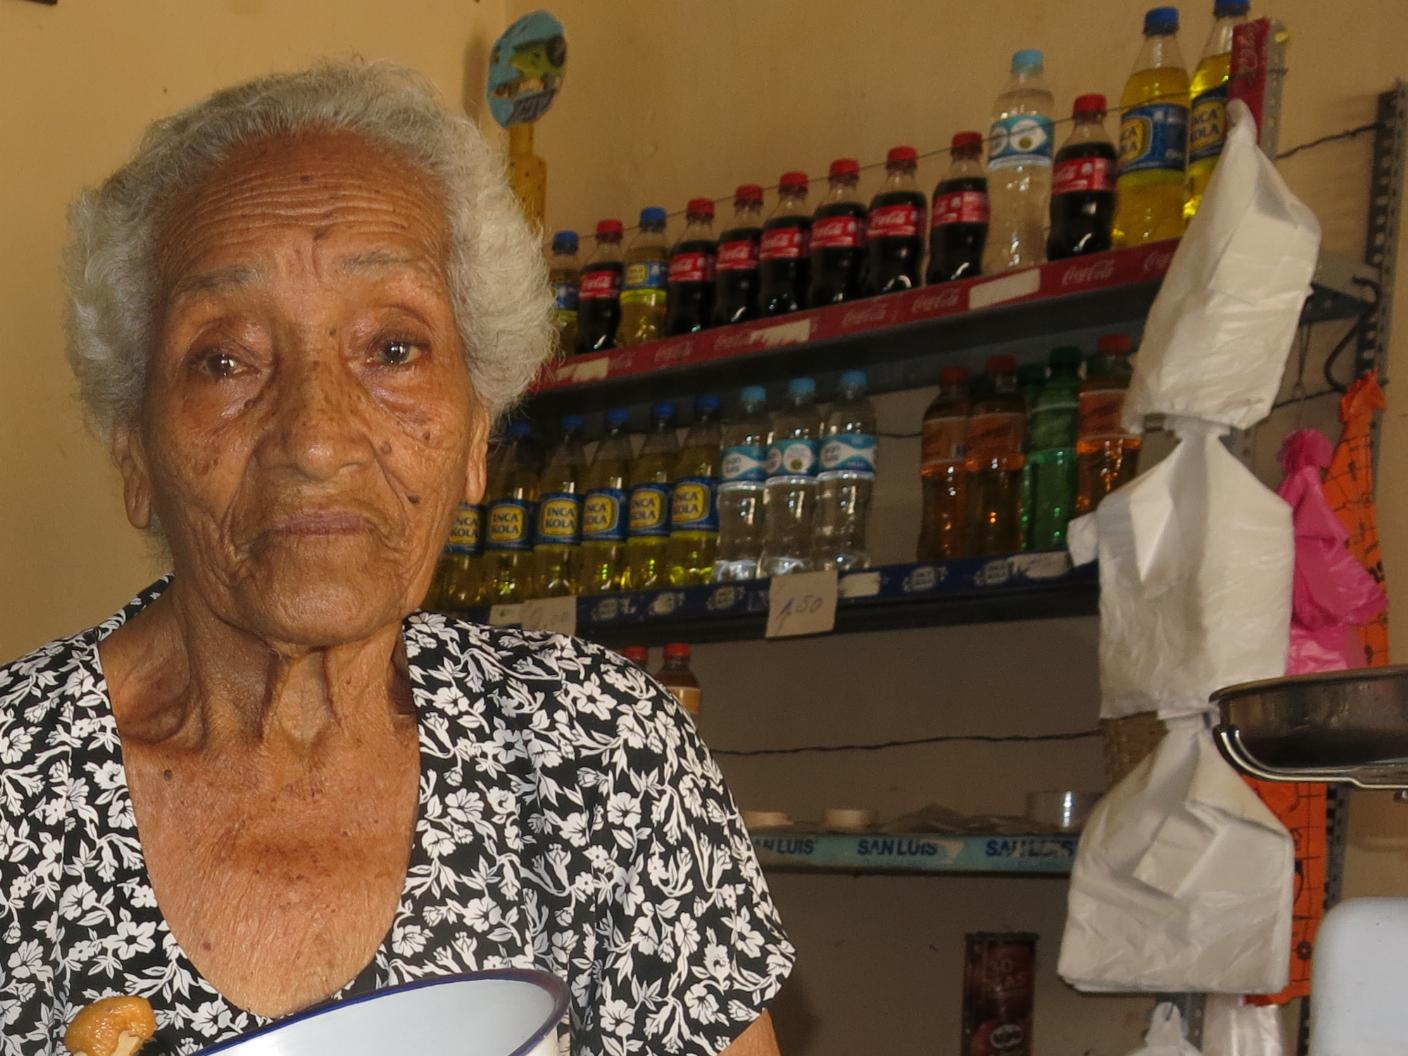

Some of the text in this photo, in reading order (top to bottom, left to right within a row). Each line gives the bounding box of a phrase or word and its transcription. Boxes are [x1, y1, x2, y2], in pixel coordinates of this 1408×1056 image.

[776, 839, 813, 855] LUIS
[857, 839, 893, 856] SAN
[896, 840, 938, 856] LUIS
